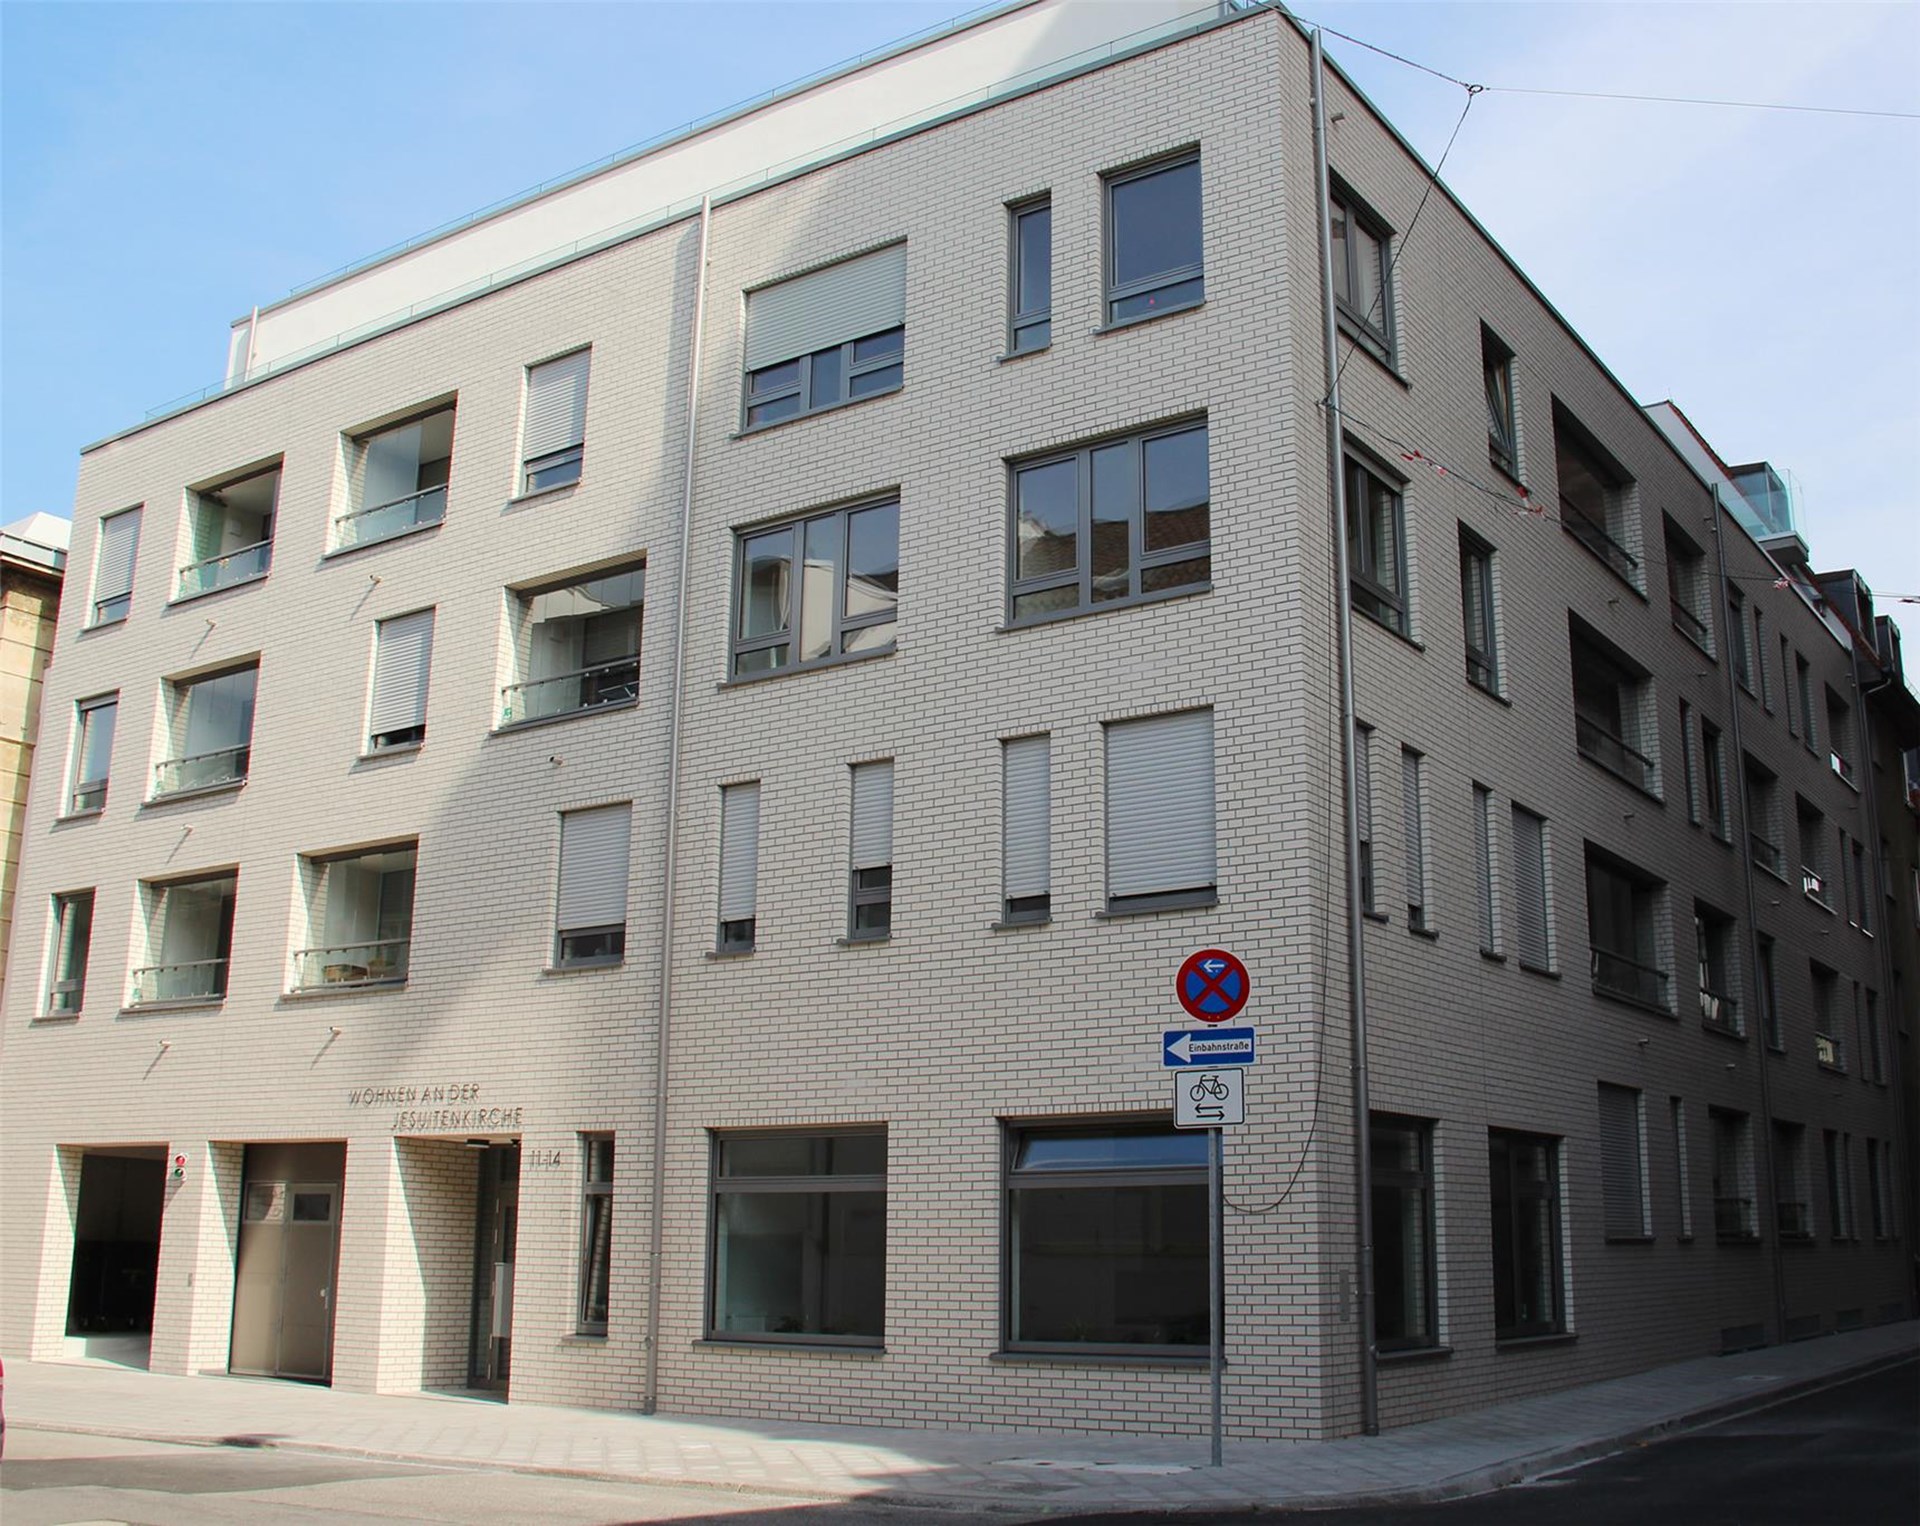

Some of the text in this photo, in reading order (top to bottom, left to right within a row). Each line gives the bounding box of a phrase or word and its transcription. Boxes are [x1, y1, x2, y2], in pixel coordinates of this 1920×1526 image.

[1188, 1041, 1250, 1052] Einbahnstraße
[349, 1083, 481, 1104] WOHNEN AN DER
[393, 1107, 523, 1128] JESUITENKIRCHE
[531, 1150, 561, 1166] 11-14
